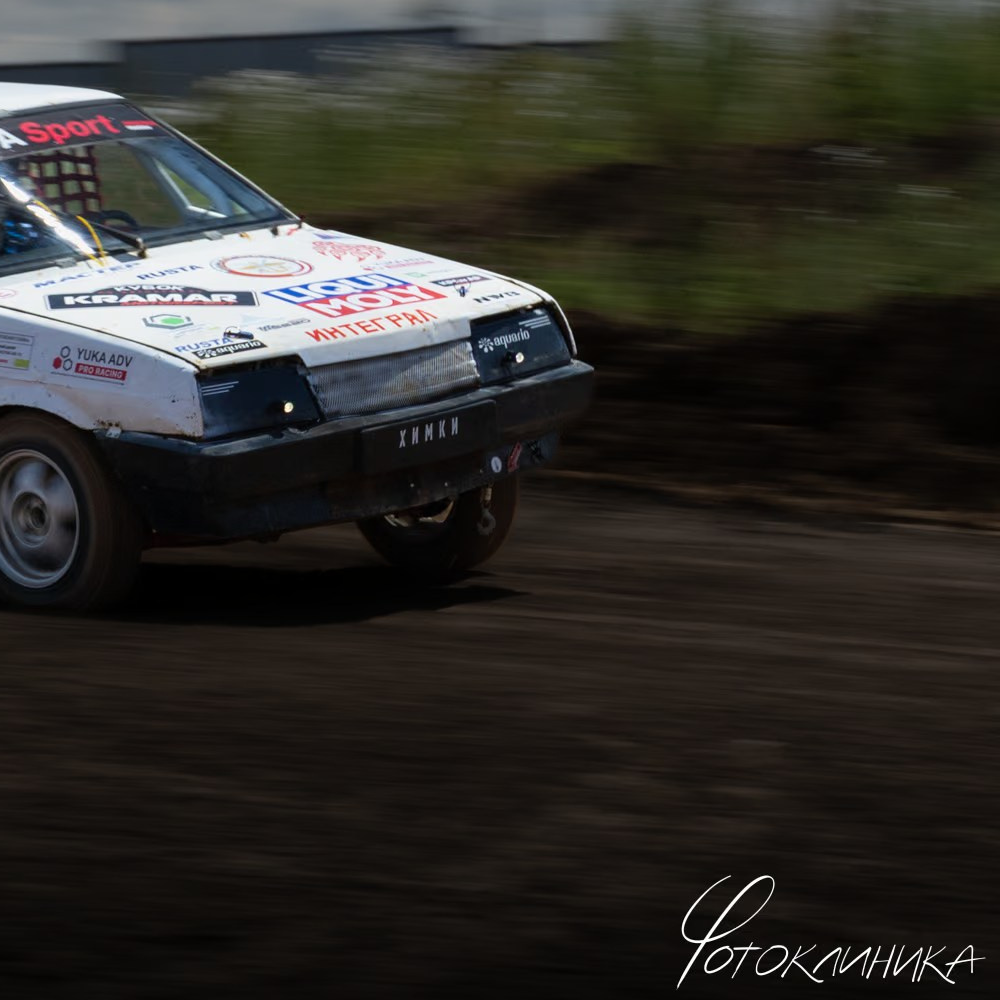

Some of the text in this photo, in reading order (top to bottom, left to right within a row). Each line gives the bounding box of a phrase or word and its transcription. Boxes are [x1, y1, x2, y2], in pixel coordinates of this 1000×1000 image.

[19, 114, 120, 145] Sport
[137, 264, 202, 280] RUSTA
[273, 273, 403, 303] LIQUI
[63, 293, 238, 305] KRAMAR
[314, 285, 429, 316] MOLY
[305, 309, 438, 342] ИНТЕГРАЛ
[175, 337, 234, 353] RUSTA
[217, 340, 262, 355] aquario
[493, 329, 530, 348] aquario
[76, 348, 134, 367] YUKA ADV
[78, 365, 123, 379] PRO RACING
[399, 416, 459, 448] ХИМКИ
